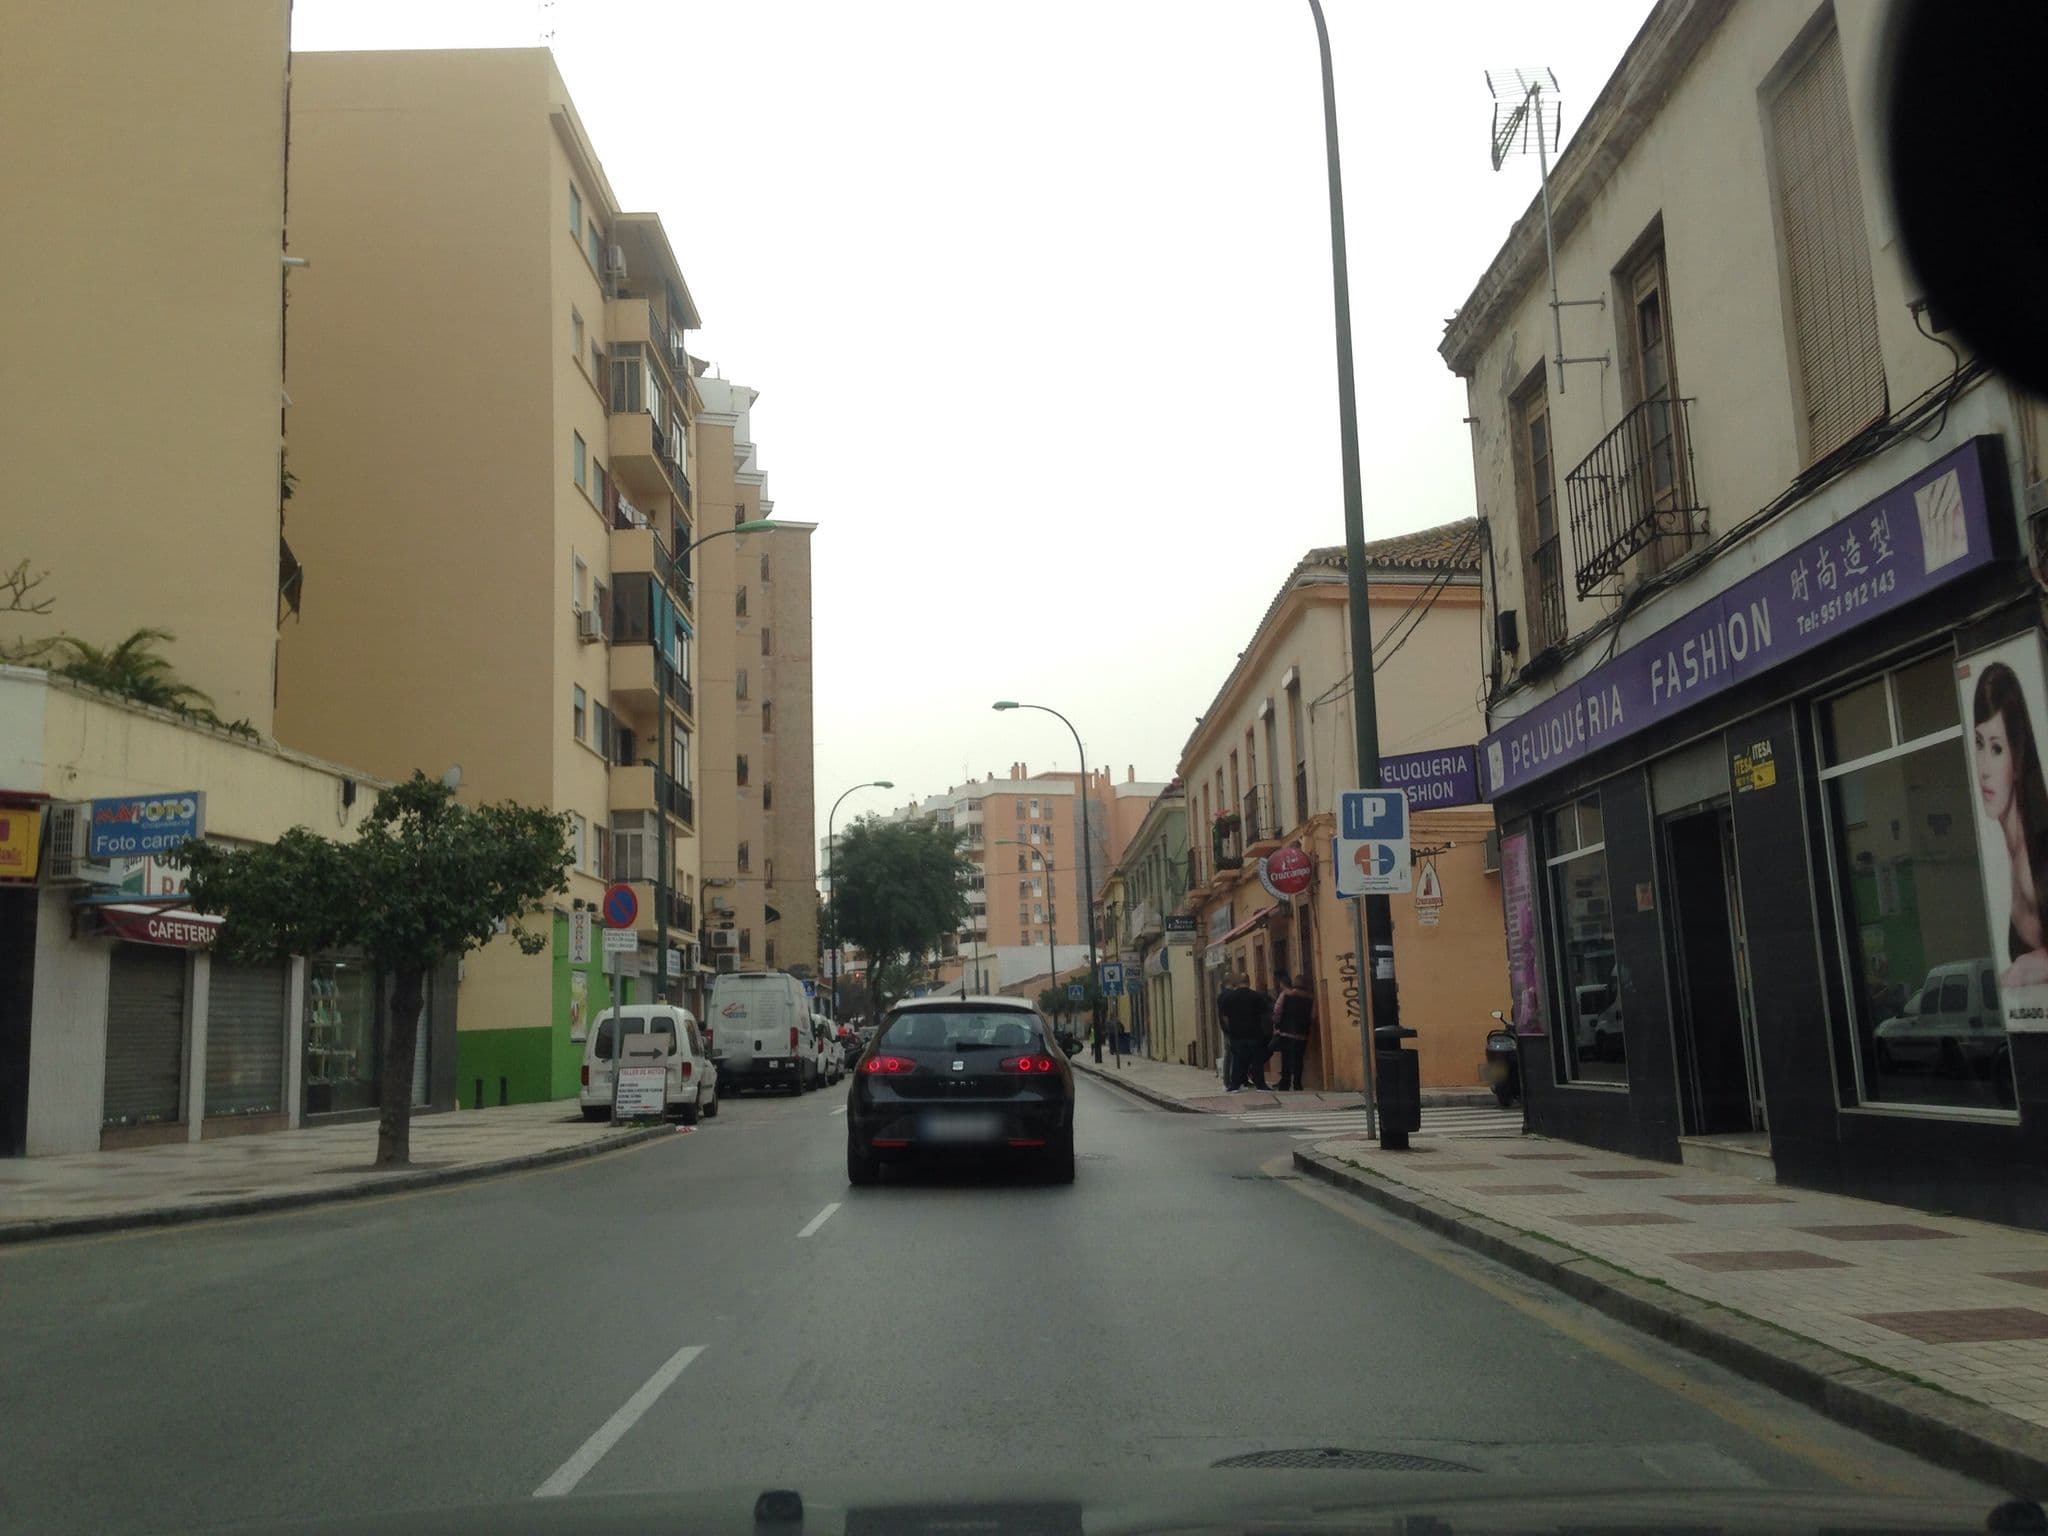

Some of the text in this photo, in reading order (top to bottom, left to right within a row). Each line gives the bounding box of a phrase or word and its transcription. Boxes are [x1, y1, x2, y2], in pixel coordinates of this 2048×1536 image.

[1797, 568, 1896, 635] Tel: 951 912 143
[1511, 596, 1772, 775] PELUQUERIA FASHION
[1380, 755, 1468, 783] ELUQUERIA
[1407, 781, 1454, 803] SHION
[1362, 797, 1386, 827] P
[97, 834, 136, 852] Foto
